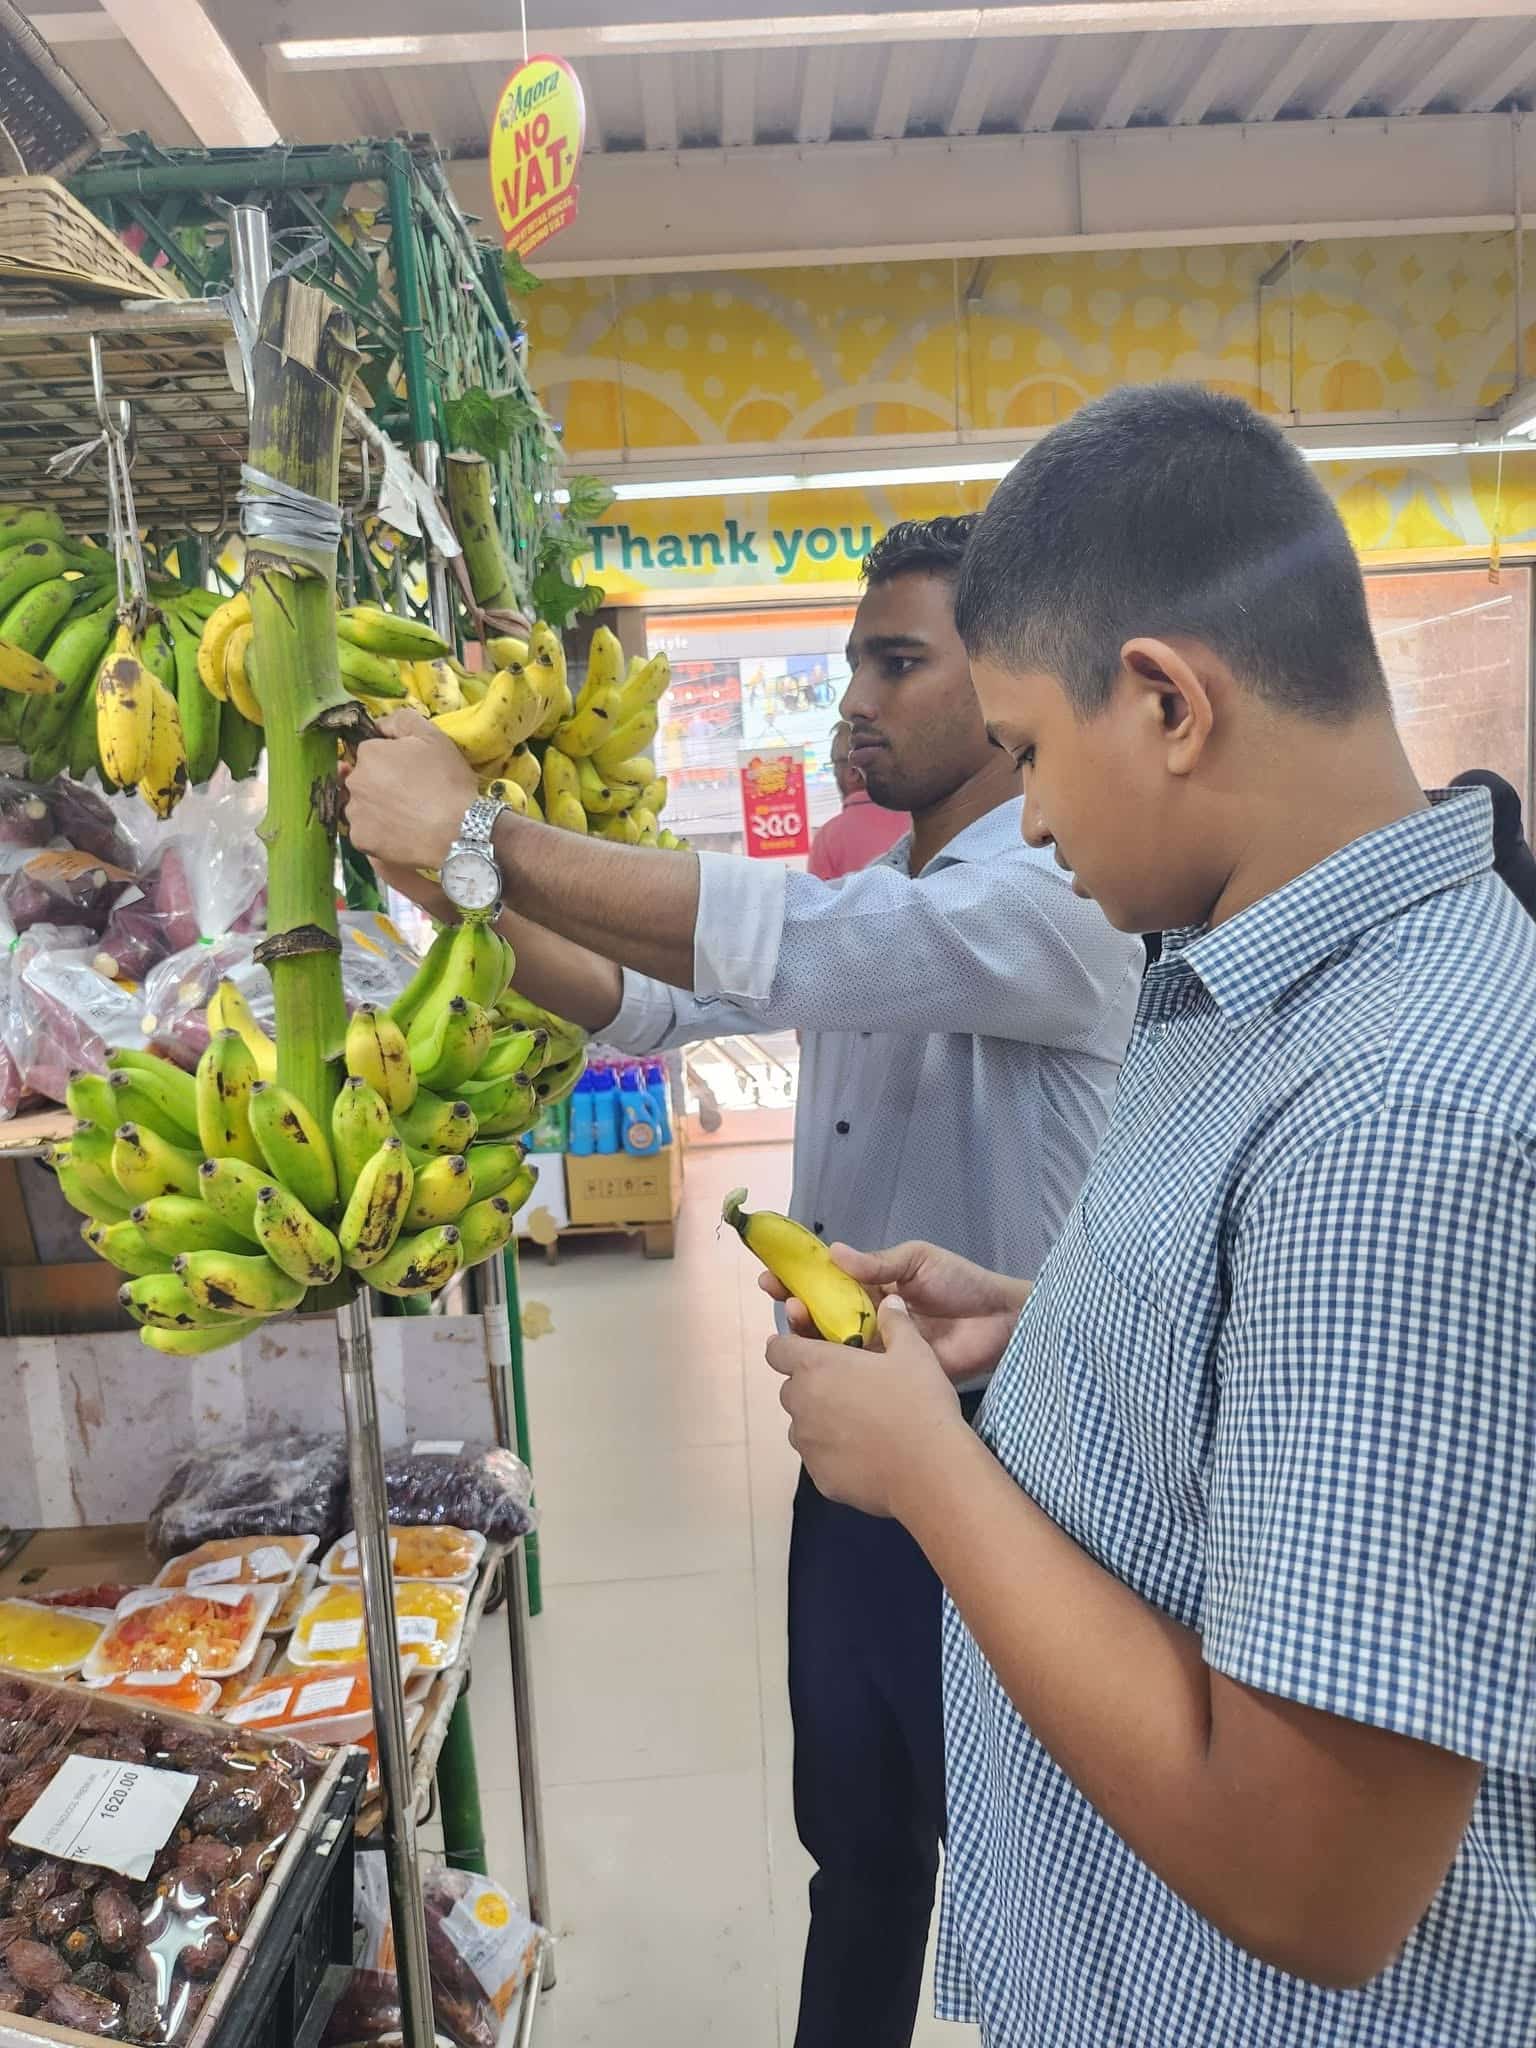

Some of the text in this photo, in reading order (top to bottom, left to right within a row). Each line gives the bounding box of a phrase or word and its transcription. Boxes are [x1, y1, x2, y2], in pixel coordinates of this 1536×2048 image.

[514, 71, 560, 120] Agora
[514, 113, 550, 162] NO
[501, 136, 567, 218] VAT
[587, 520, 873, 575] Thank you
[101, 1772, 138, 1819] 1620.00
